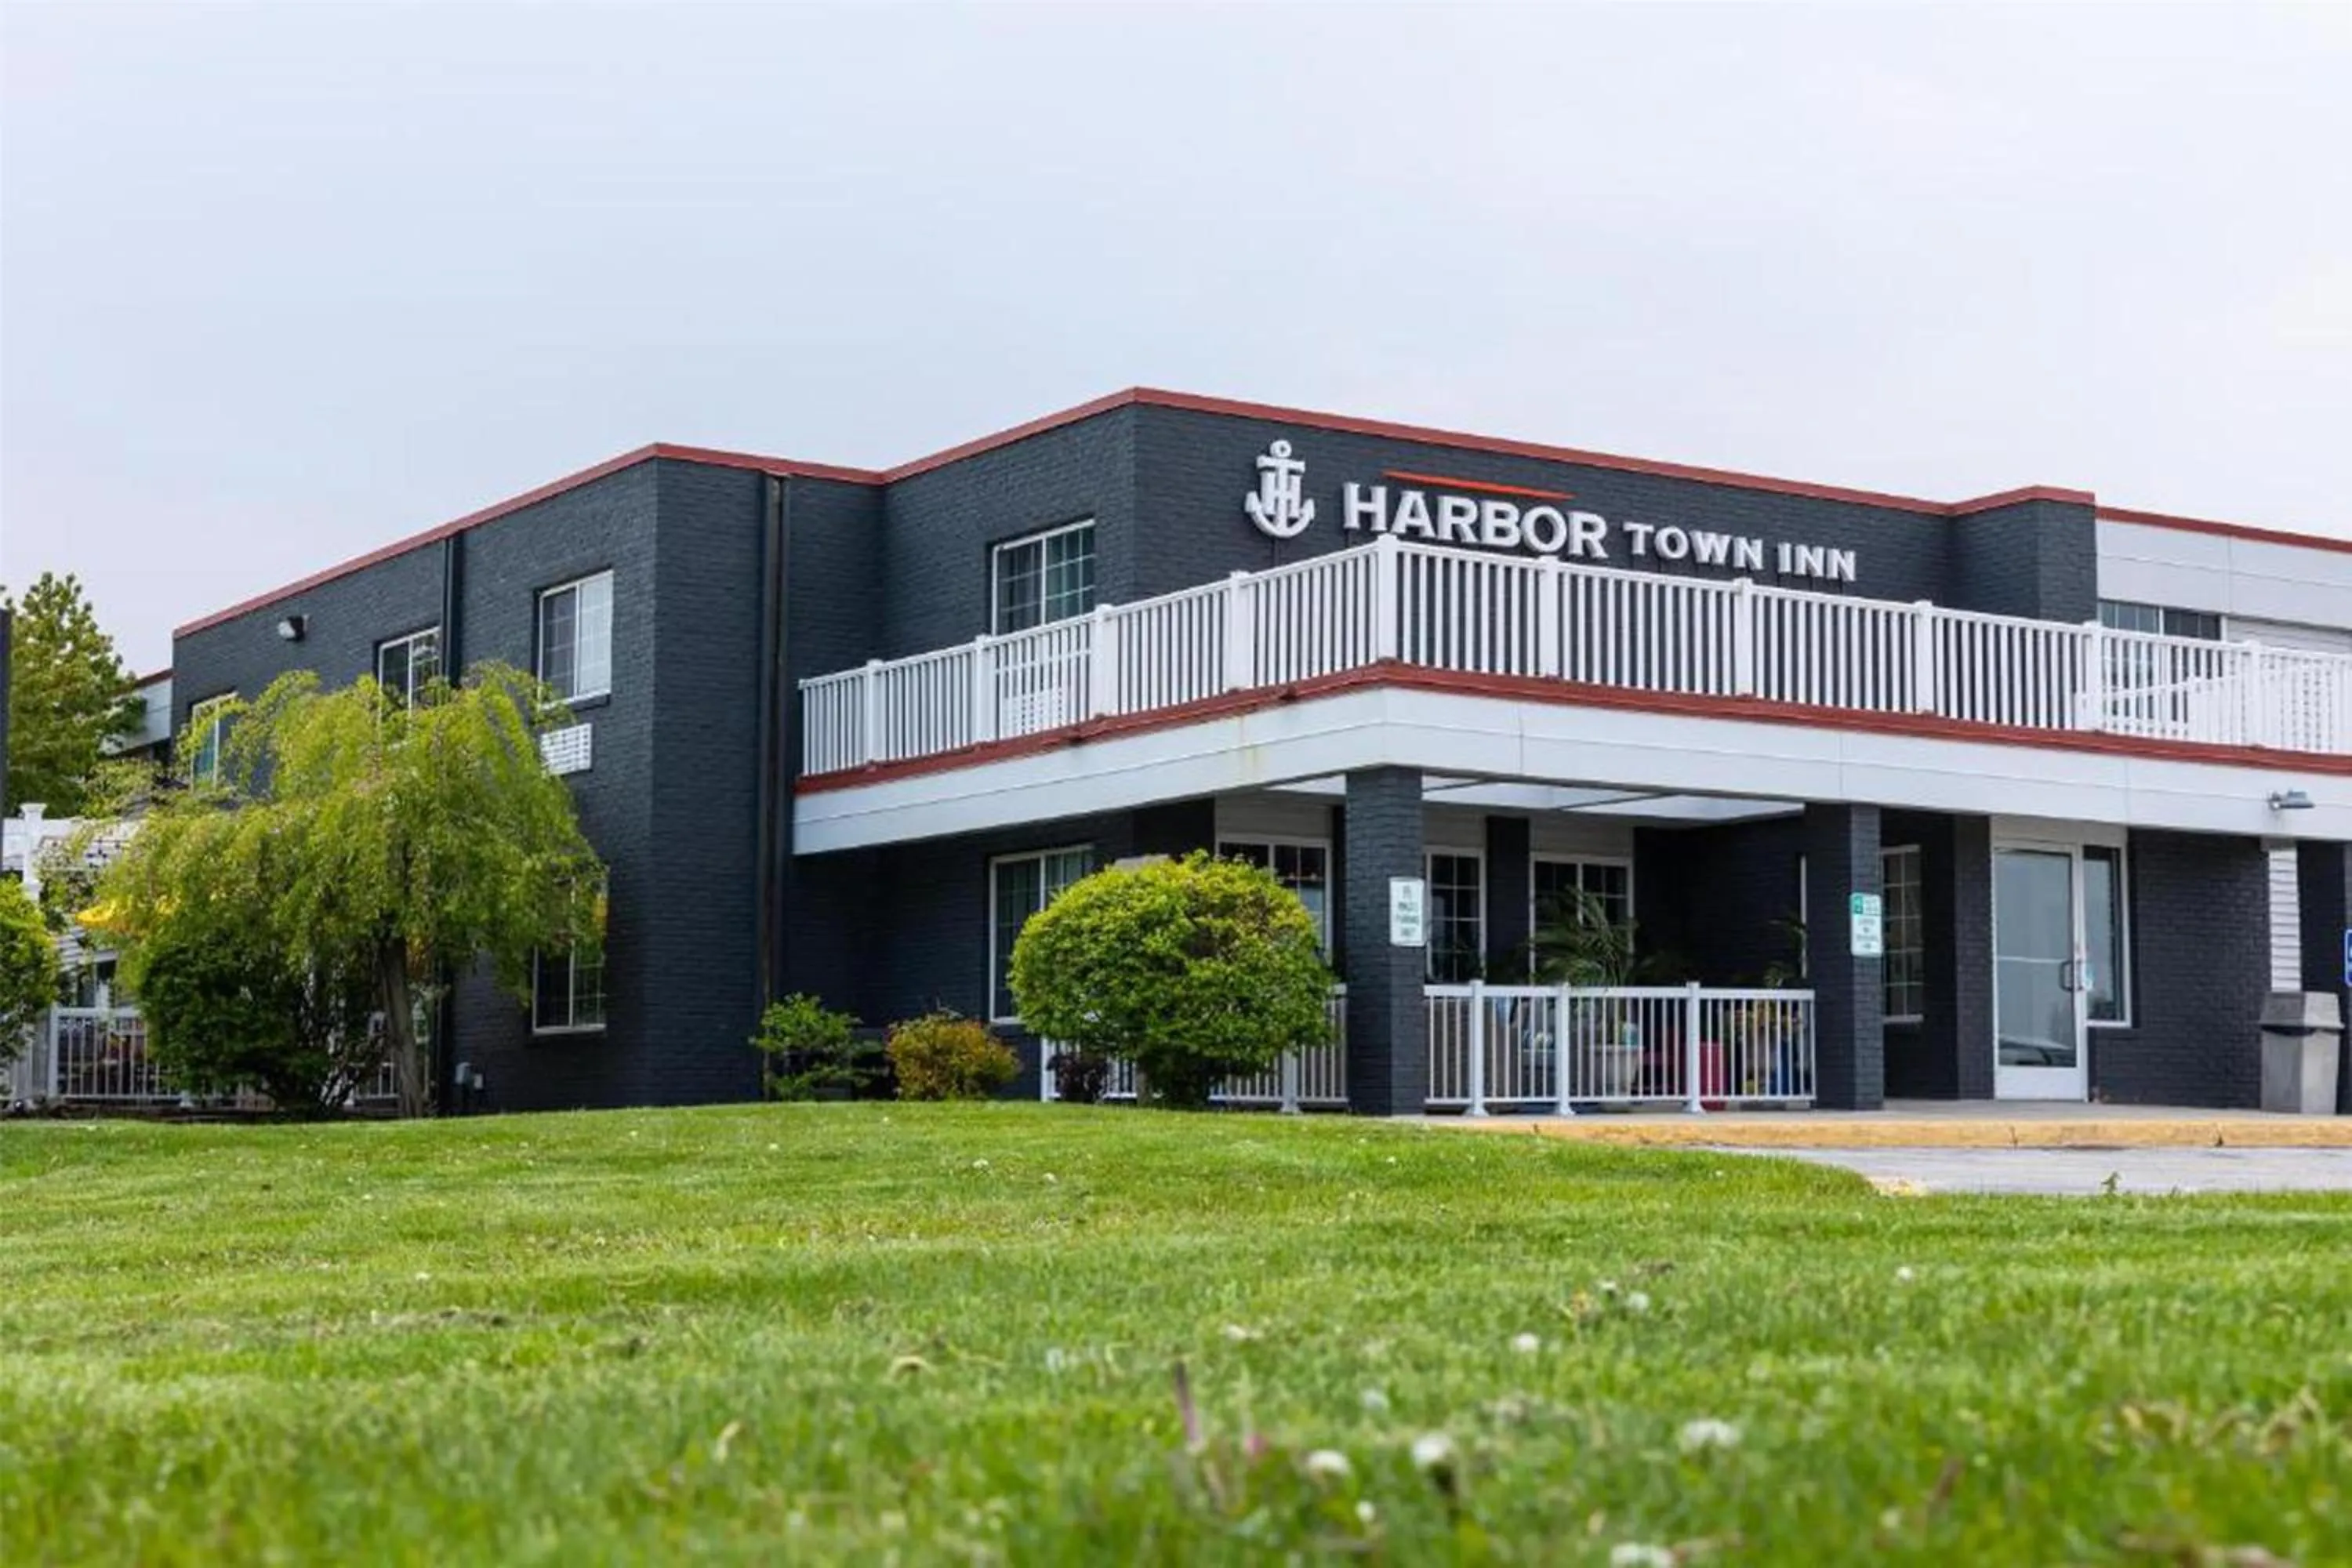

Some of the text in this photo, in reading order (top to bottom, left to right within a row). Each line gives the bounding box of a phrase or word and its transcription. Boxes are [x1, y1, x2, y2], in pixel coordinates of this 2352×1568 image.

[1343, 481, 1856, 581] HARBOR TOWN INN
